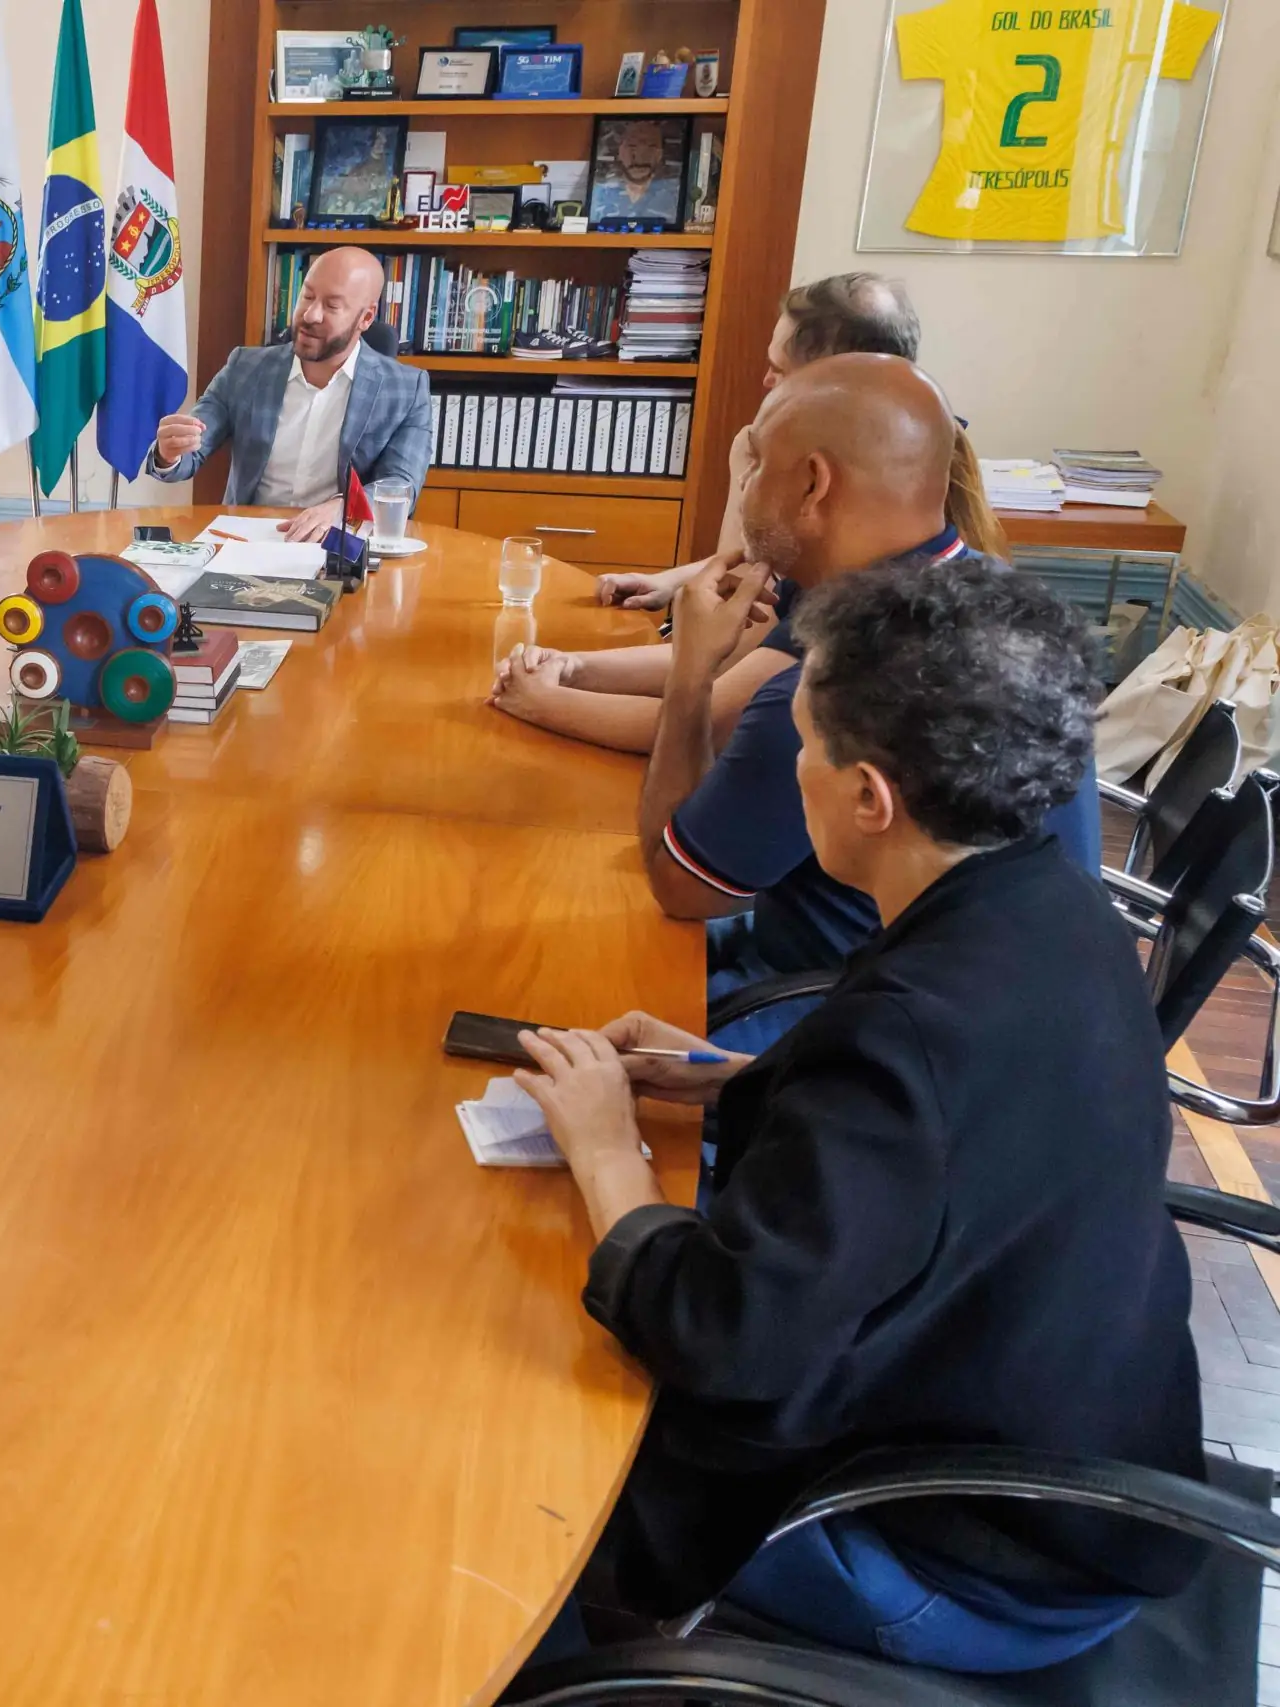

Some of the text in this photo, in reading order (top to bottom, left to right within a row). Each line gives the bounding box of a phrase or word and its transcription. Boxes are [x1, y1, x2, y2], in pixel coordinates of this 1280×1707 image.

[992, 8, 1114, 31] GOL DO BRASIL
[544, 55, 562, 64] TIM
[999, 54, 1061, 147] 2
[969, 168, 1070, 190] TERESÓPOLIS
[418, 195, 443, 212] EU
[416, 208, 470, 230] TERÊ
